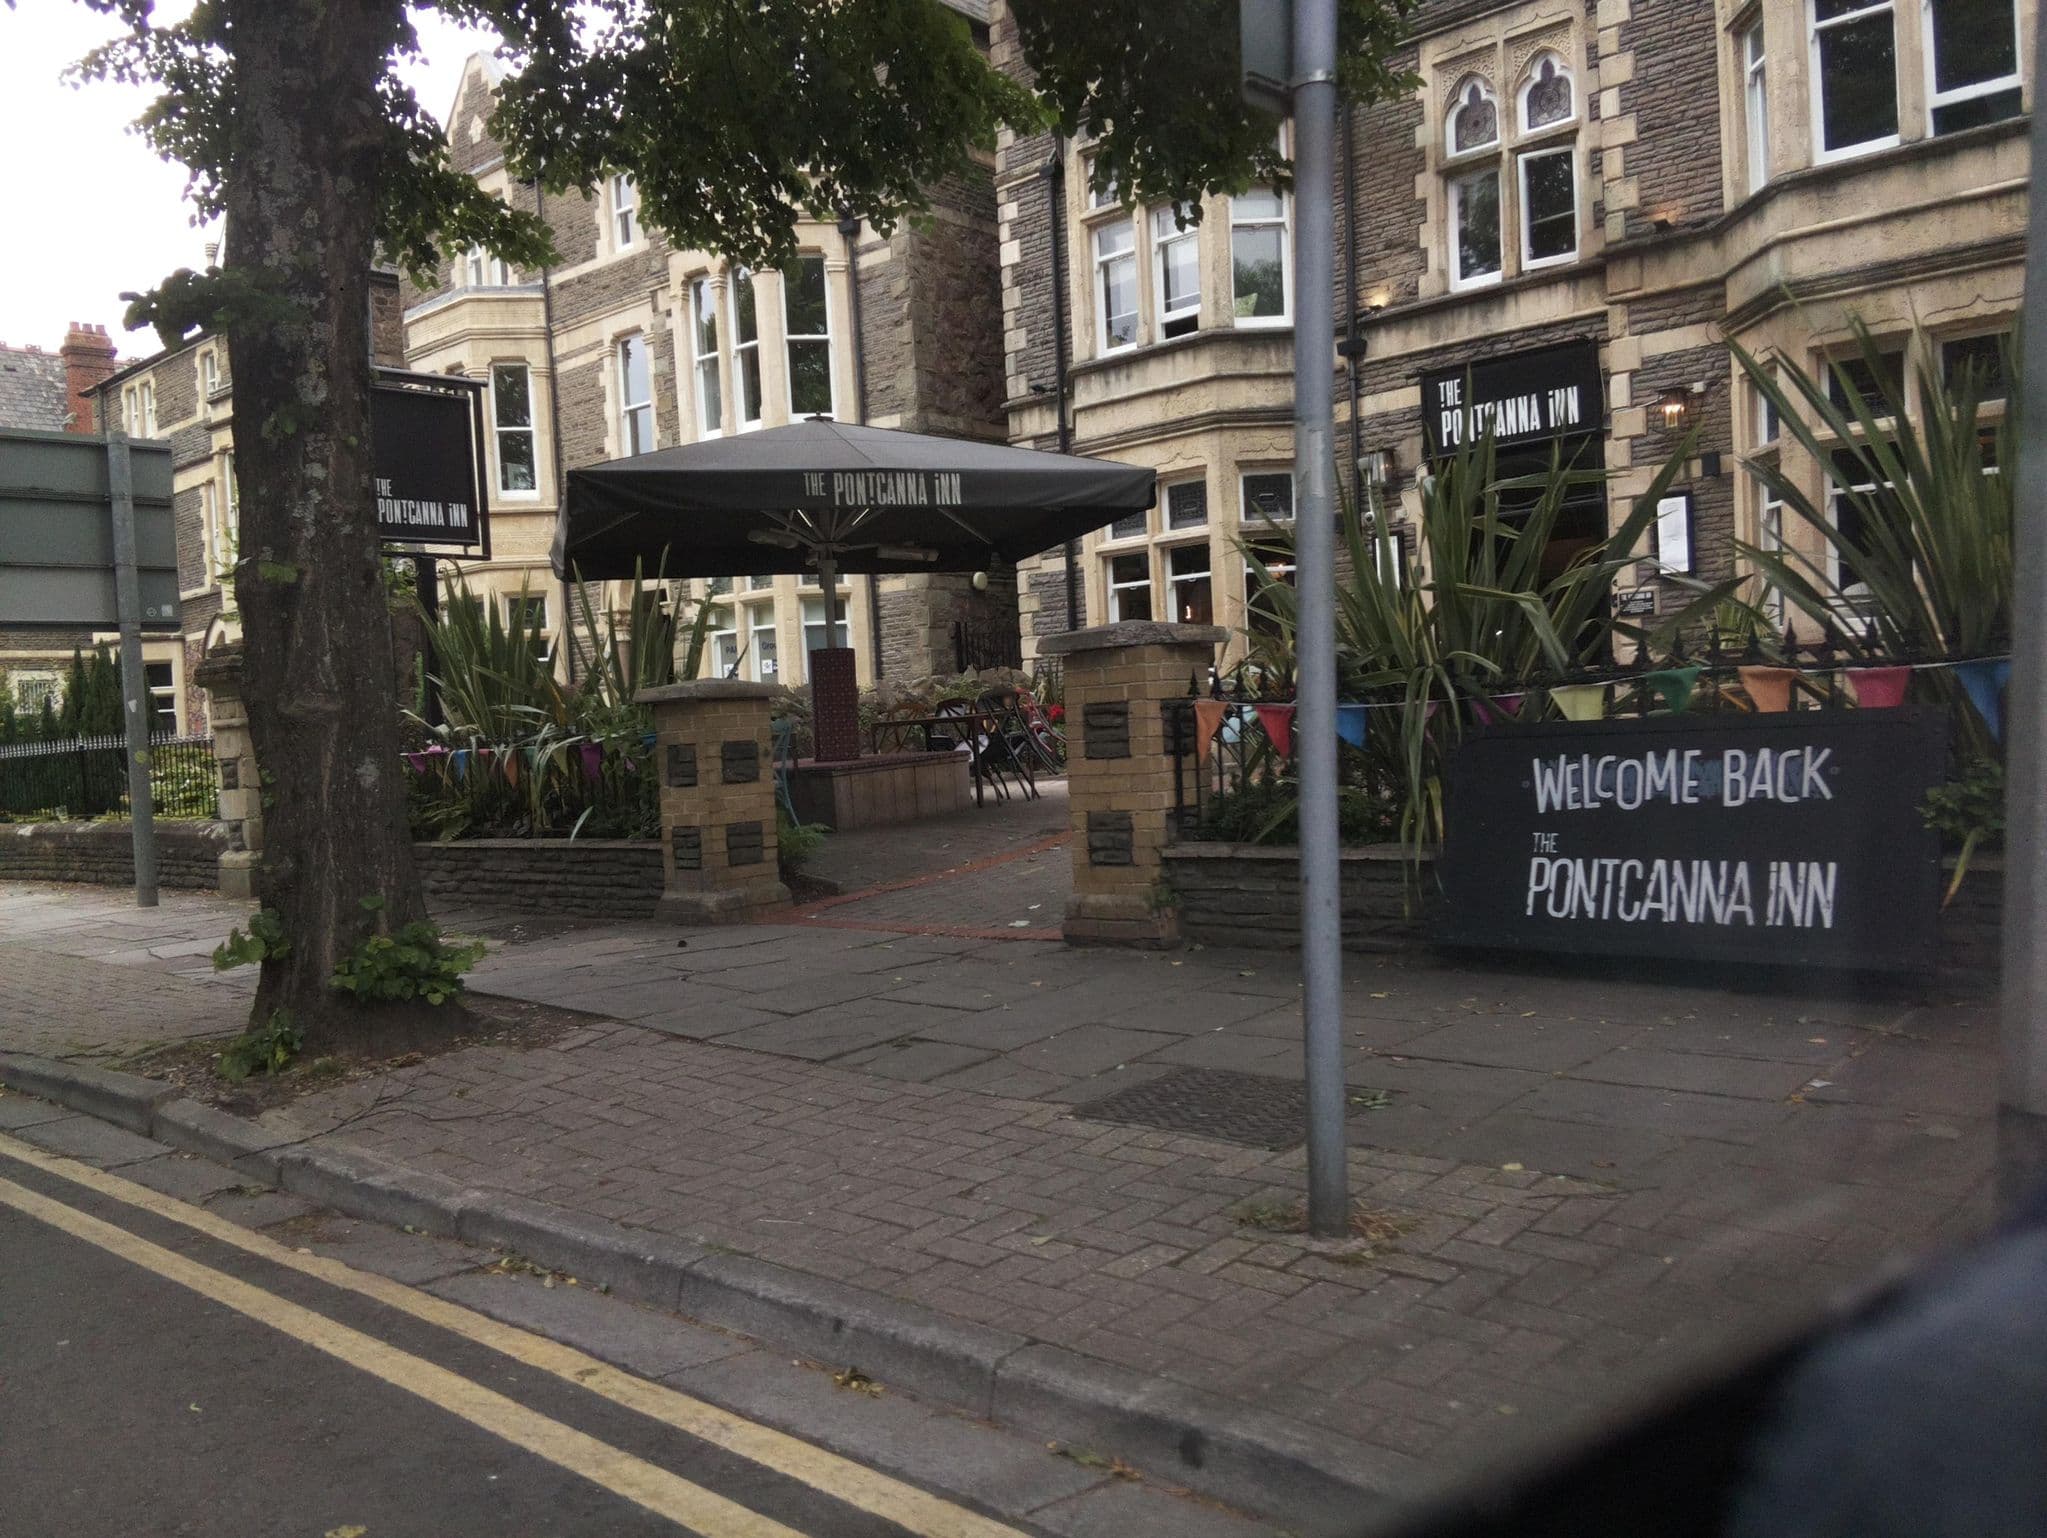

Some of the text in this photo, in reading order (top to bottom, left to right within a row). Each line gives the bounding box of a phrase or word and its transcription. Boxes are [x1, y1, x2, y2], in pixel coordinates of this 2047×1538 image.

[1438, 379, 1462, 408] THE
[376, 478, 392, 497] THE
[803, 472, 826, 496] THE
[833, 472, 928, 506] PONTCANNA
[377, 499, 445, 526] PONTCANNA
[1533, 746, 1834, 813] WELCOME BACK
[1533, 832, 1559, 853] THE
[1526, 857, 1755, 926] PONTCANNA
